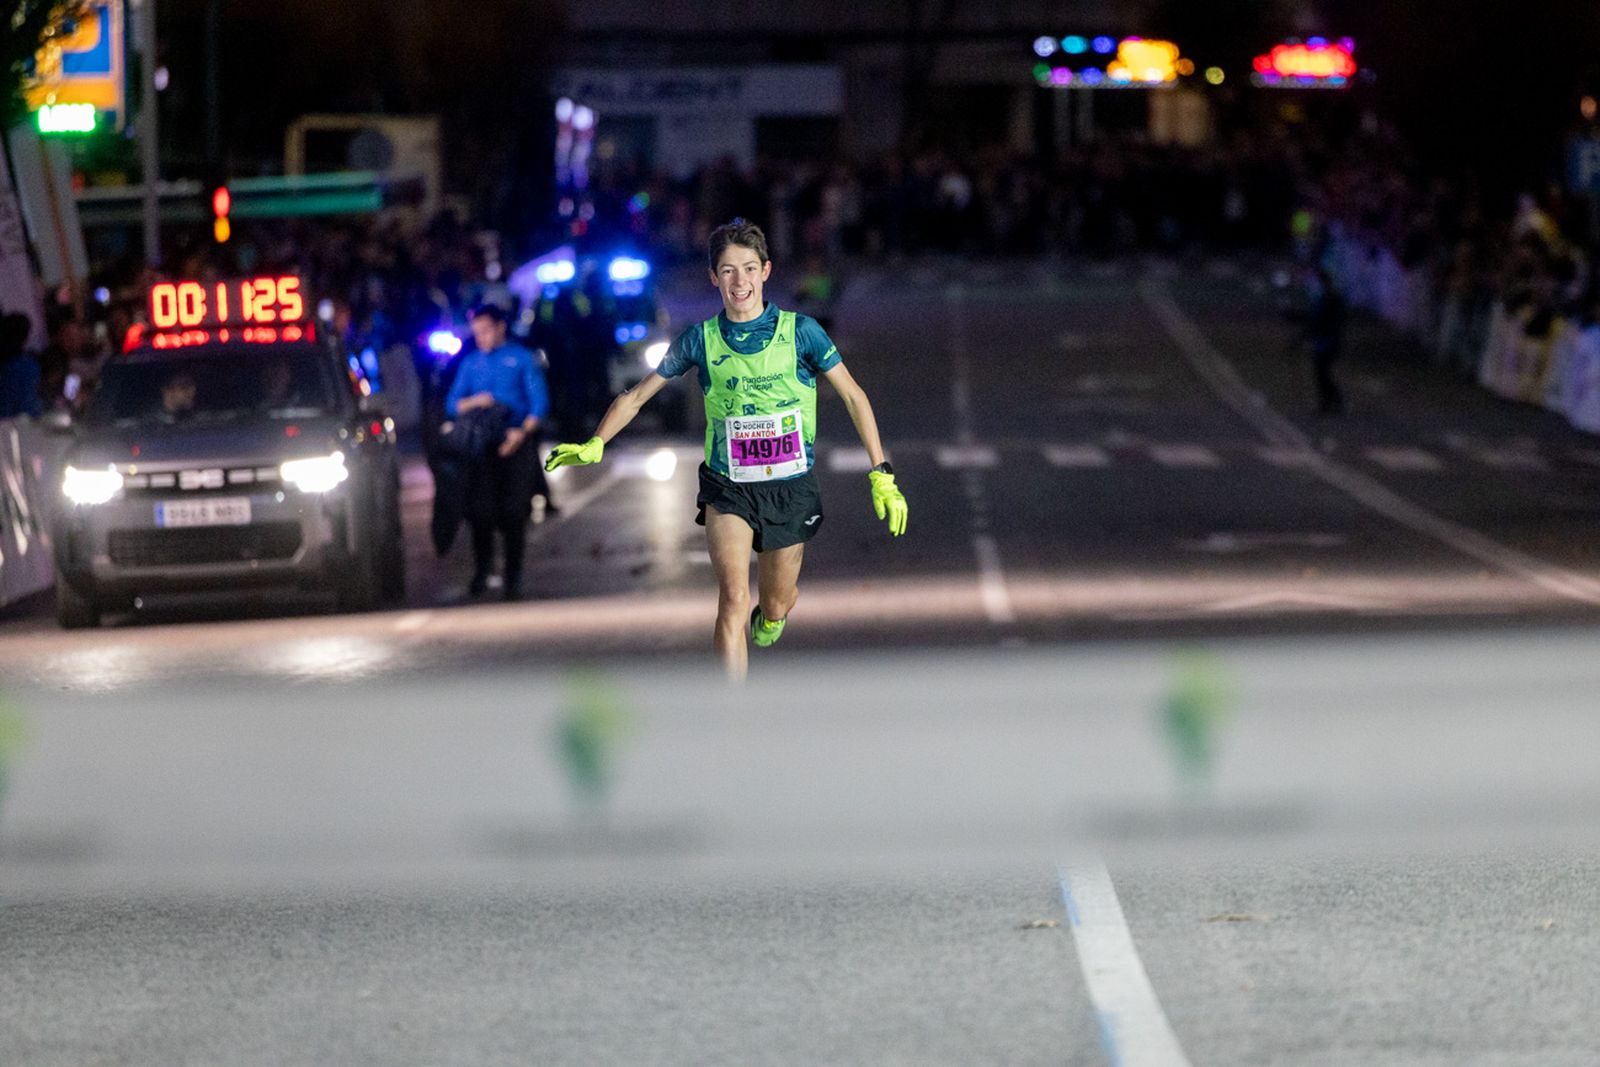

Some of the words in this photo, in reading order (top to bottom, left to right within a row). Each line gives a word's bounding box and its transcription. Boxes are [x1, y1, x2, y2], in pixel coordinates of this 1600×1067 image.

[742, 373, 783, 384] Fundación
[743, 382, 772, 391] Unicaja
[742, 422, 765, 430] NOCHE
[766, 421, 775, 429] DE
[738, 434, 793, 459] 14976
